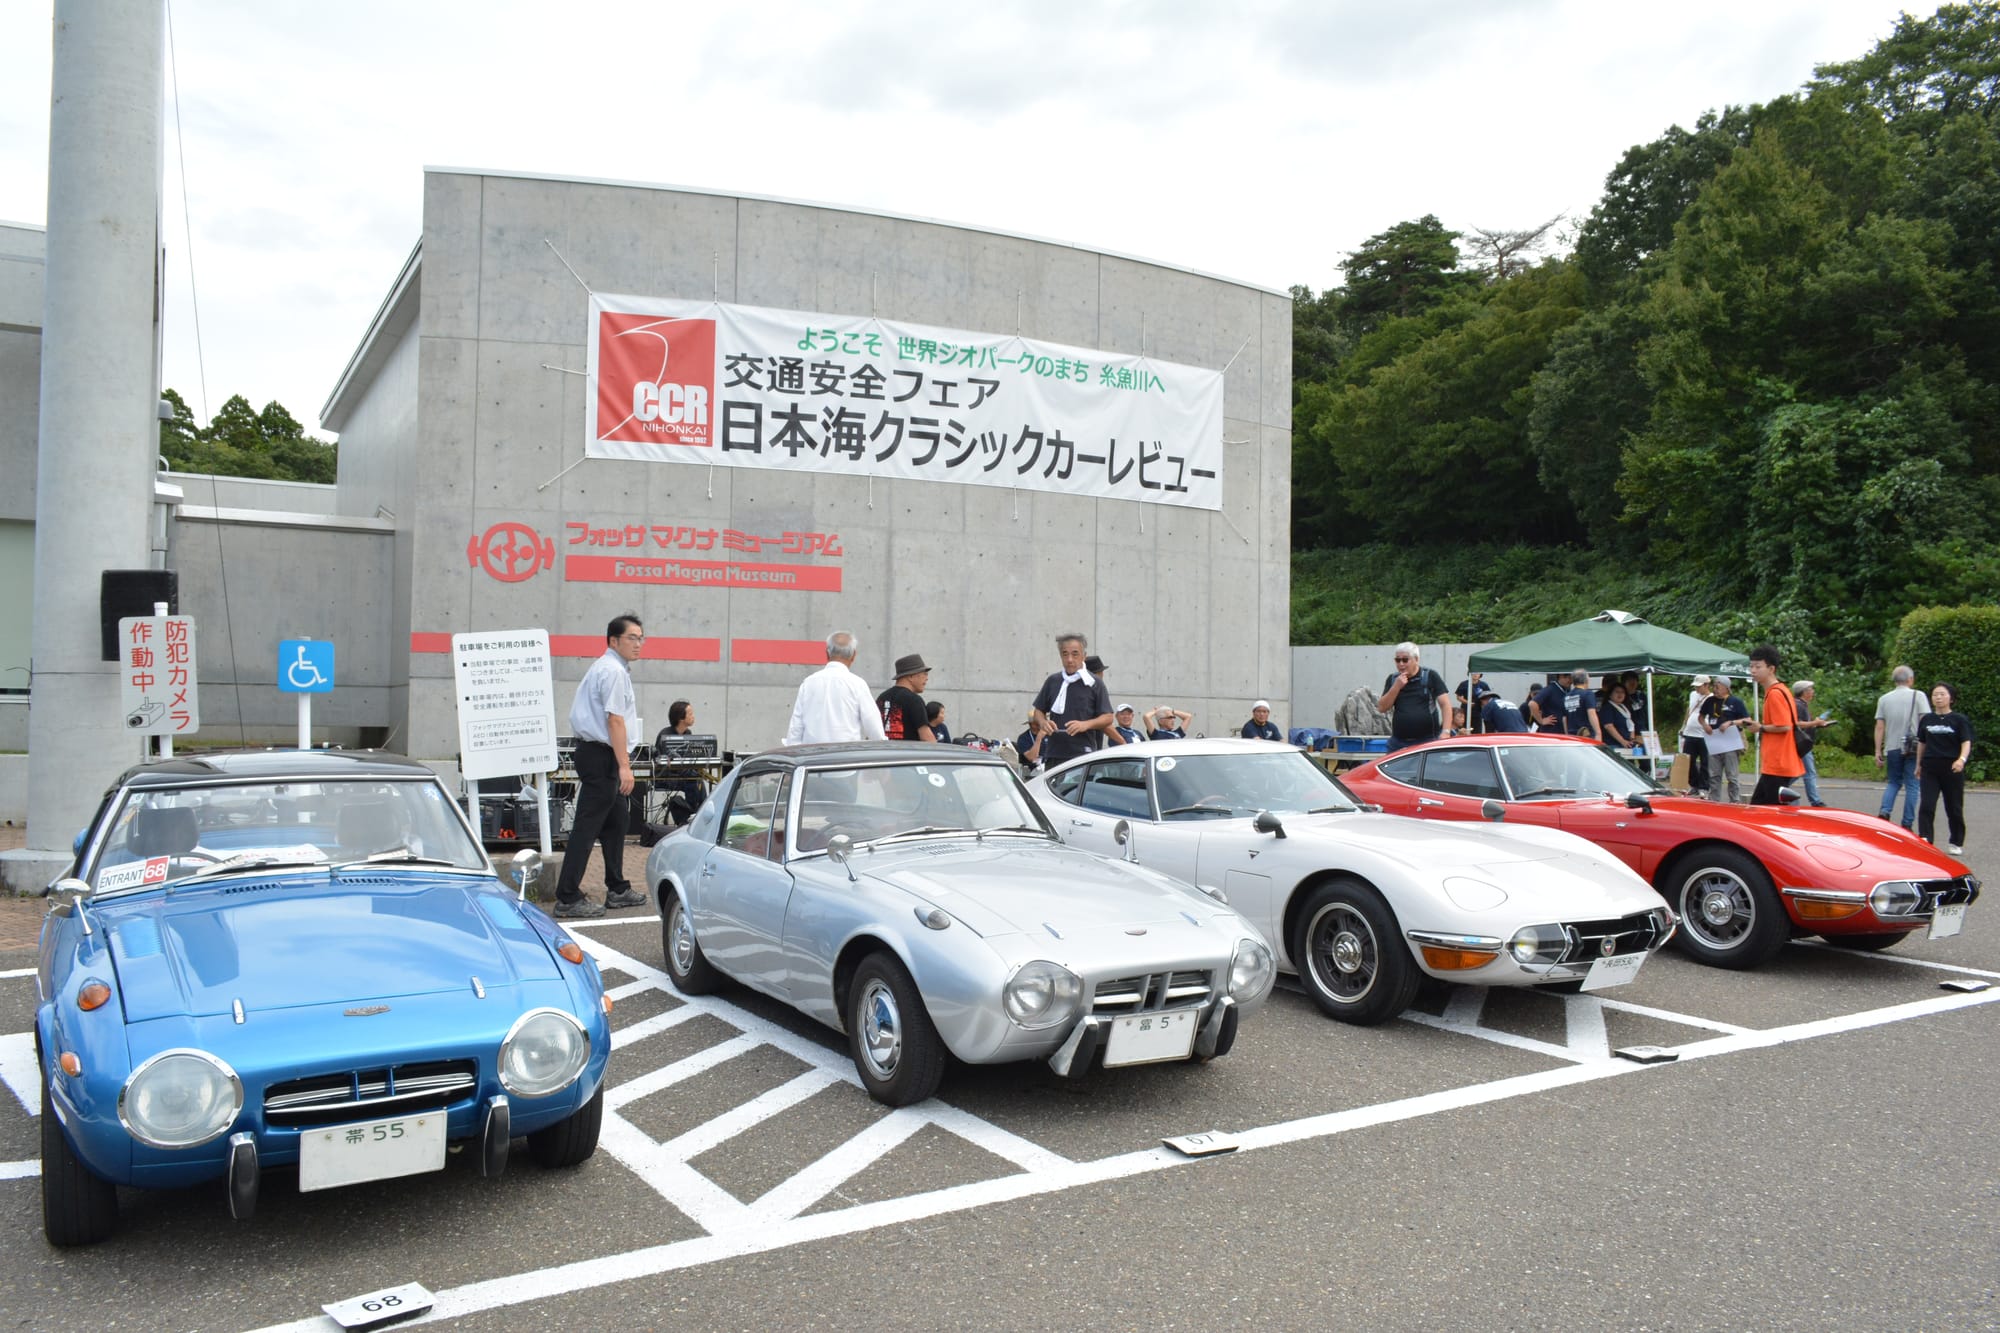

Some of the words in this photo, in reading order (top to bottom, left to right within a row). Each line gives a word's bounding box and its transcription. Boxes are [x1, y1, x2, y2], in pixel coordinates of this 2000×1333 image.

[797, 327, 883, 357] ようこそ
[897, 337, 1089, 383] 世界ジオパークのまち
[1099, 364, 1166, 393] 糸魚川へ
[724, 353, 1001, 410] 交通安全フェア
[642, 423, 707, 436] NIHONKAI
[722, 400, 1216, 493] 日本海クラシックカーレビュー
[566, 522, 648, 547] フォッサ
[651, 526, 719, 550] マグナ
[723, 529, 843, 556] ミュージアム
[615, 561, 663, 578] Fossa
[665, 563, 723, 582] Magna
[725, 566, 797, 584] Museum
[130, 622, 154, 693] 作動中
[459, 641, 543, 652] 駐車場をご利用の皆様へ
[165, 620, 190, 730] 防犯カメラ
[99, 869, 144, 888] ENTRANT
[145, 863, 166, 879] 68
[1160, 1016, 1170, 1029] 5
[346, 1129, 365, 1144] 帯
[373, 1123, 405, 1141] 55
[361, 1295, 403, 1312] 68
